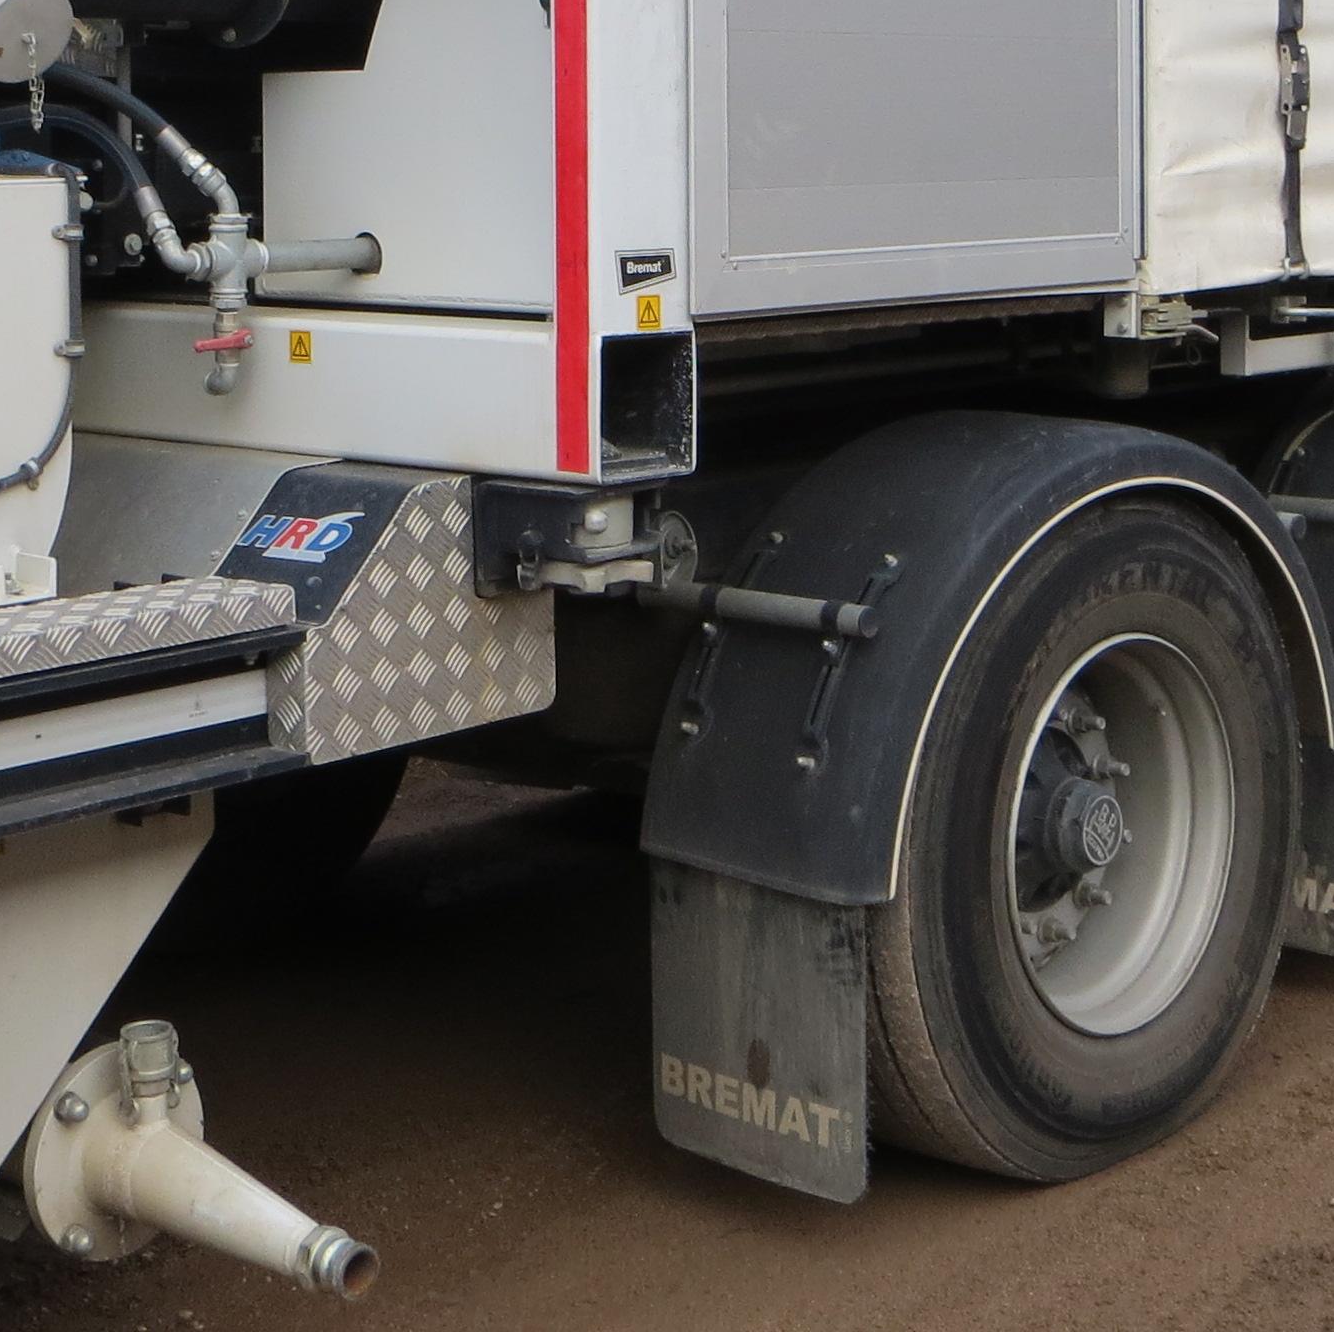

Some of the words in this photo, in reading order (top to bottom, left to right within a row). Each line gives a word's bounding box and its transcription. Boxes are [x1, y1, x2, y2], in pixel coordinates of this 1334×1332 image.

[626, 260, 662, 275] Bremat
[236, 513, 354, 554] HRD
[660, 1051, 841, 1149] BREMAT
